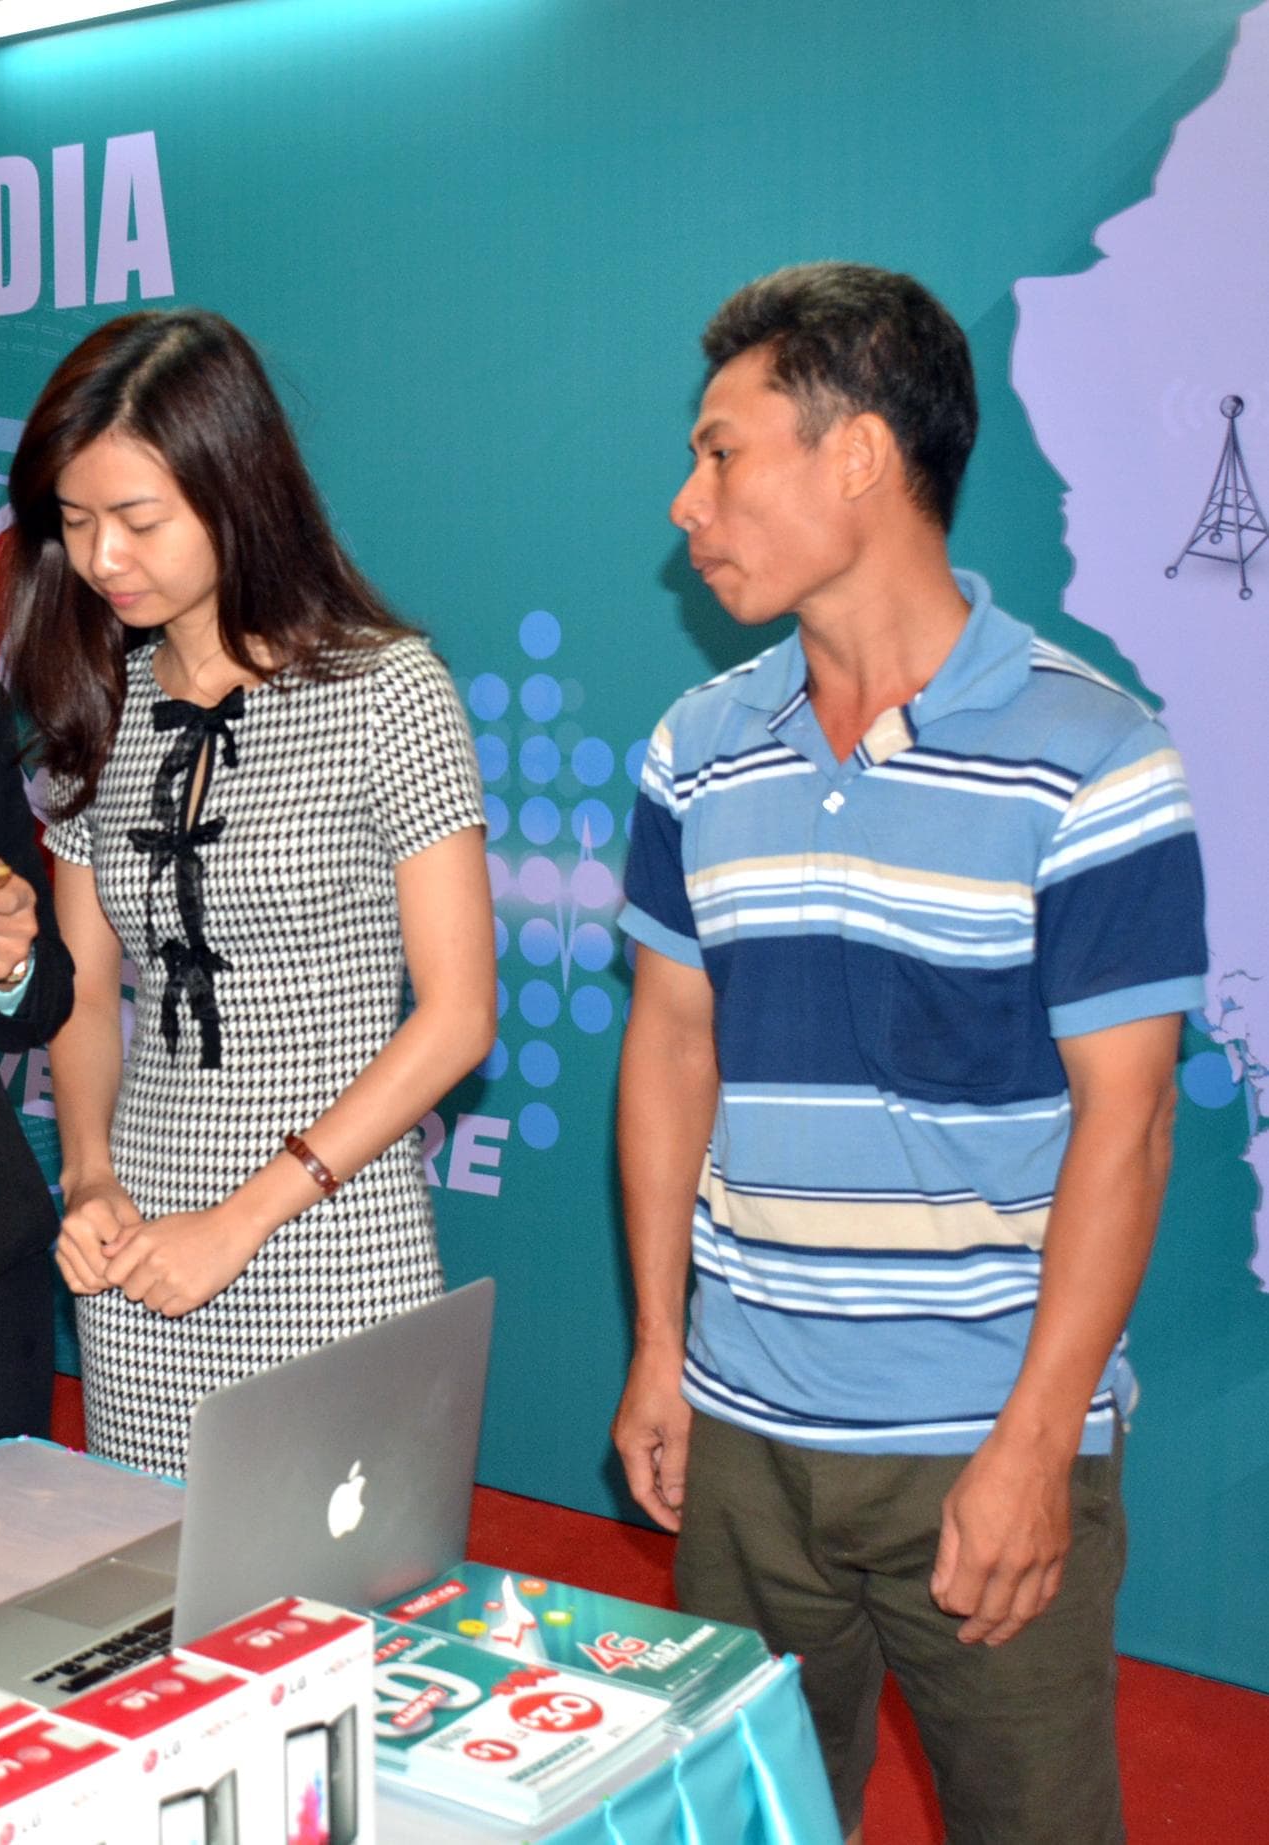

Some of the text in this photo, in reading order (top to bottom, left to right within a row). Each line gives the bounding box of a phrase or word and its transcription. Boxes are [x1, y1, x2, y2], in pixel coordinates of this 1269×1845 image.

[246, 1629, 284, 1648] LG
[577, 1632, 650, 1675] 4G
[120, 1690, 160, 1710] LG
